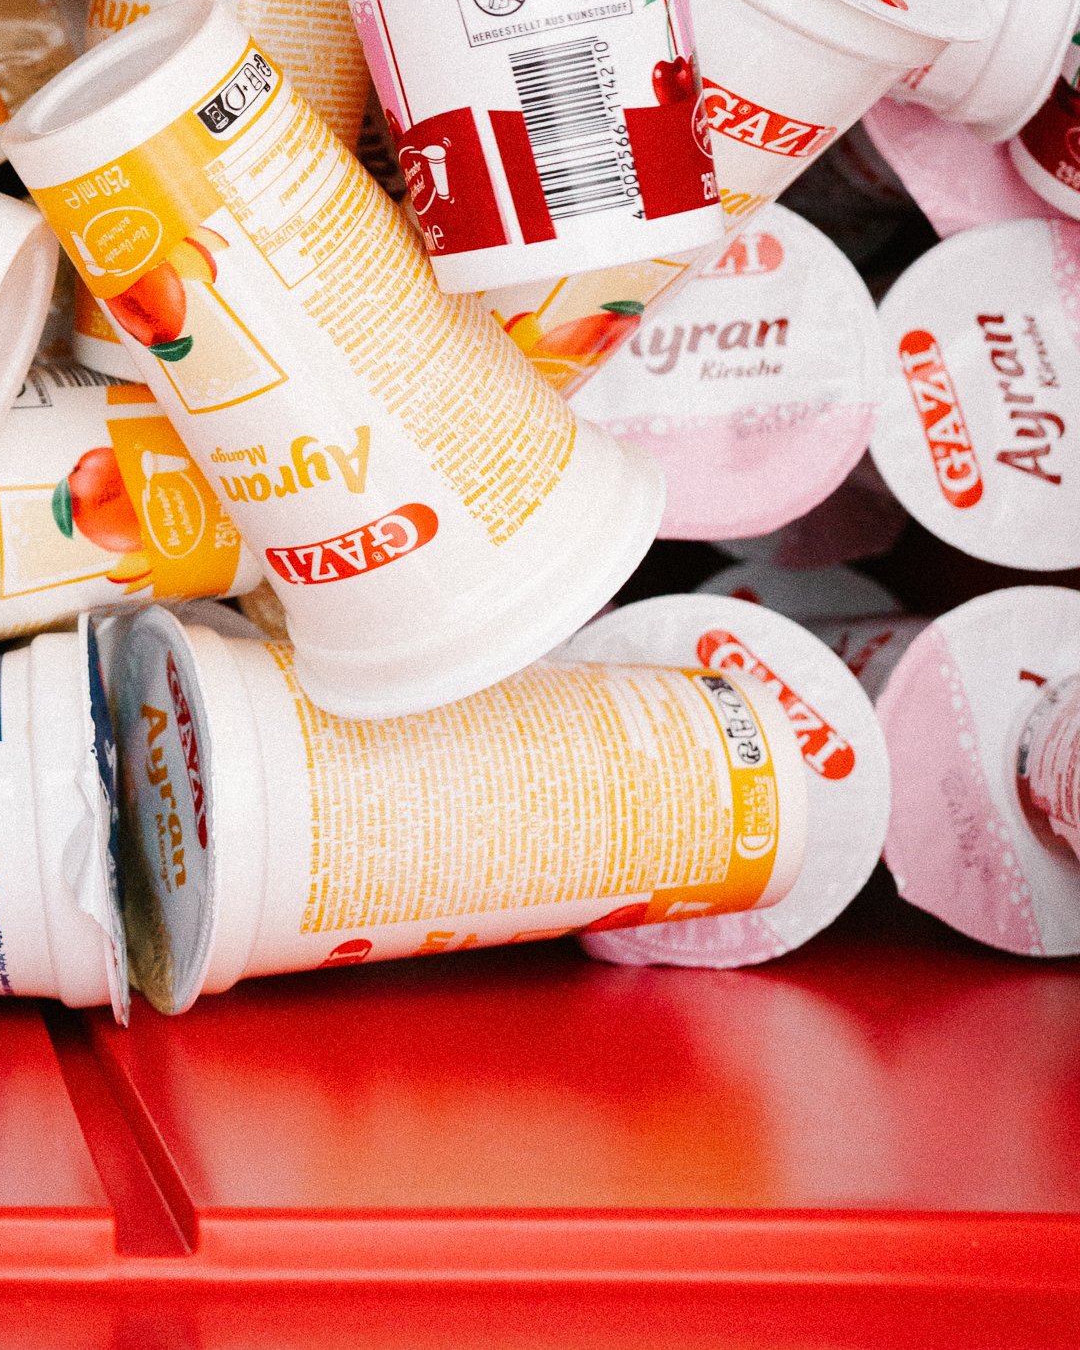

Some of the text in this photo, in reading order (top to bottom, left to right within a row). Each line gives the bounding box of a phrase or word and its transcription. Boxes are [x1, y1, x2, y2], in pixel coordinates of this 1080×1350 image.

[472, 1, 627, 43] HERGESTELLT AUS KUNSTSTOFF
[592, 39, 646, 220] 4 002566 114210
[93, 163, 131, 198] 250
[102, 225, 150, 265] Vor Verzehr
[699, 359, 784, 381] Kirsche
[976, 312, 1068, 486] Ayran
[210, 444, 267, 468] Mango
[221, 425, 373, 503] Ayran
[276, 514, 421, 581] GAZI
[141, 703, 188, 889] Ayran
[154, 814, 172, 894] Mango
